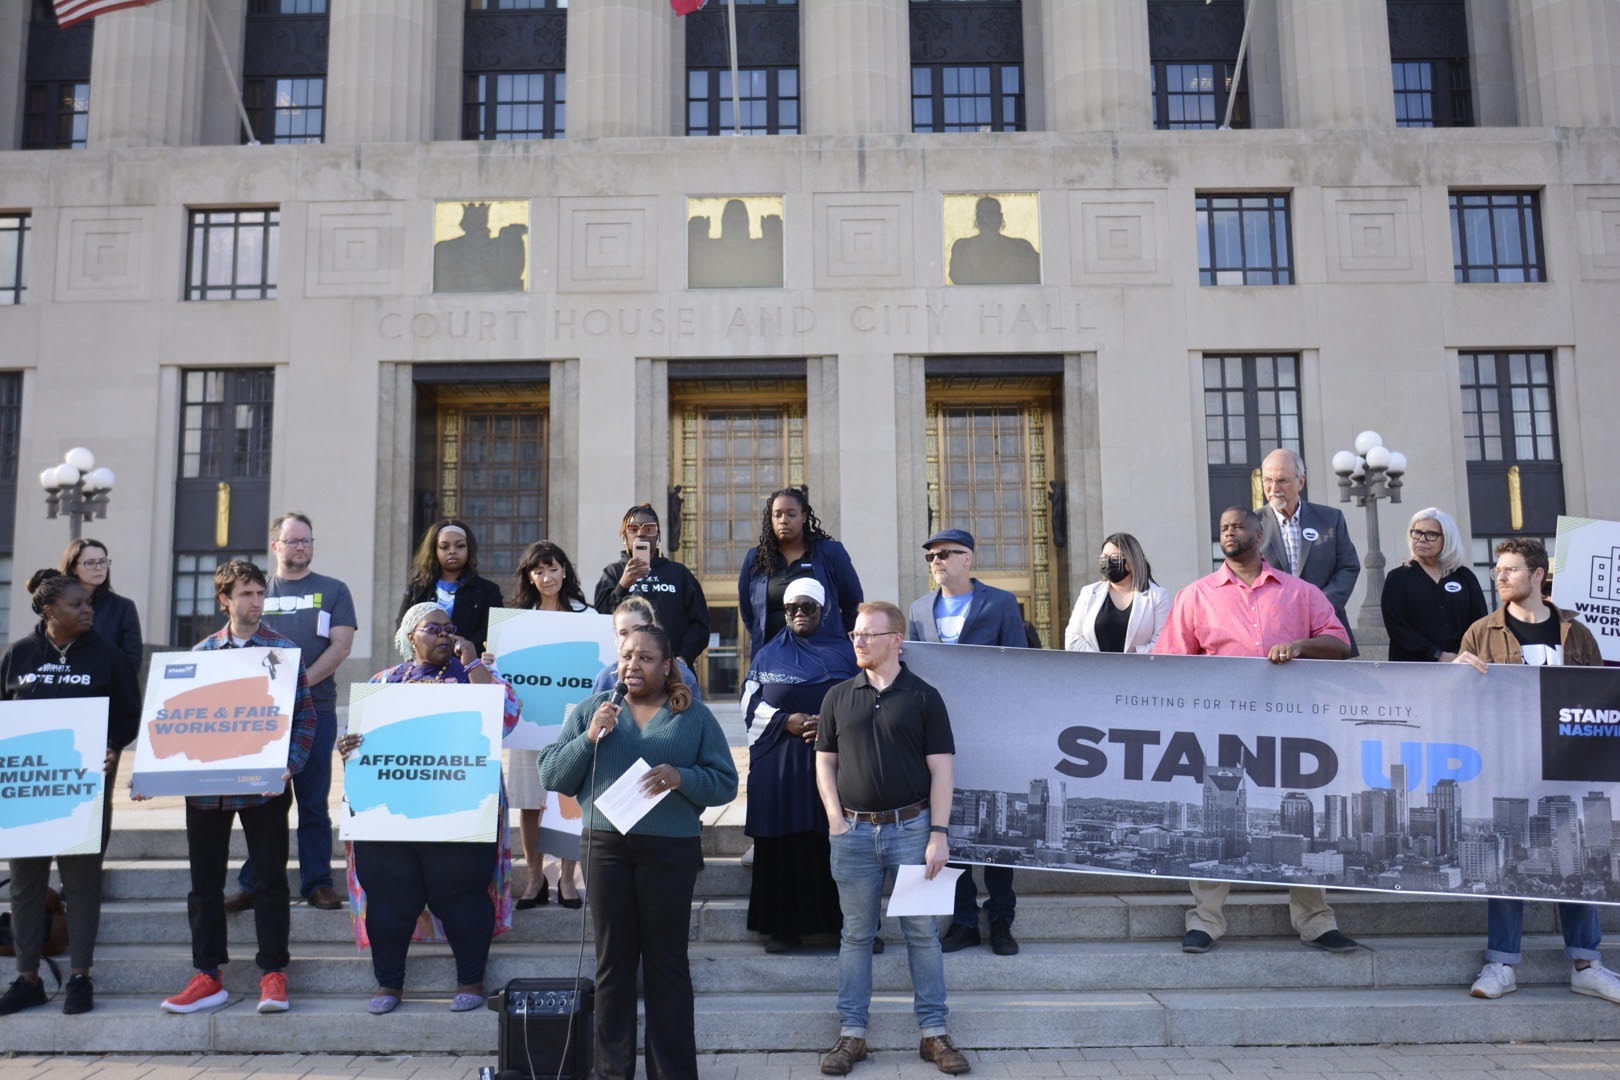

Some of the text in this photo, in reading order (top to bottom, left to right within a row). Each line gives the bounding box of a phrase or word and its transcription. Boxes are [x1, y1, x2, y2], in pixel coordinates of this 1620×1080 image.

[377, 303, 1098, 342] COURT HOUSE AND CITY HALL
[652, 583, 676, 593] MOB
[1575, 602, 1620, 616] WHER
[1584, 614, 1620, 626] WOR
[18, 673, 91, 685] VOTE MOB
[501, 673, 593, 688] GOOD JOB
[1115, 694, 1185, 708] FIGHTING
[1193, 698, 1221, 710] FOR
[1230, 700, 1257, 712] THE
[1265, 701, 1303, 714] SOUL
[1312, 703, 1330, 715] OF
[1339, 705, 1368, 716] OUR
[156, 705, 280, 720] SAFE & FAIR
[1559, 708, 1620, 724] STAND
[155, 720, 278, 734] WORKSITES
[359, 755, 487, 767] AFFORDABLE
[1053, 725, 1482, 794] STAND UP
[377, 769, 467, 781] HOUSING
[1, 782, 97, 799] GEMENT
